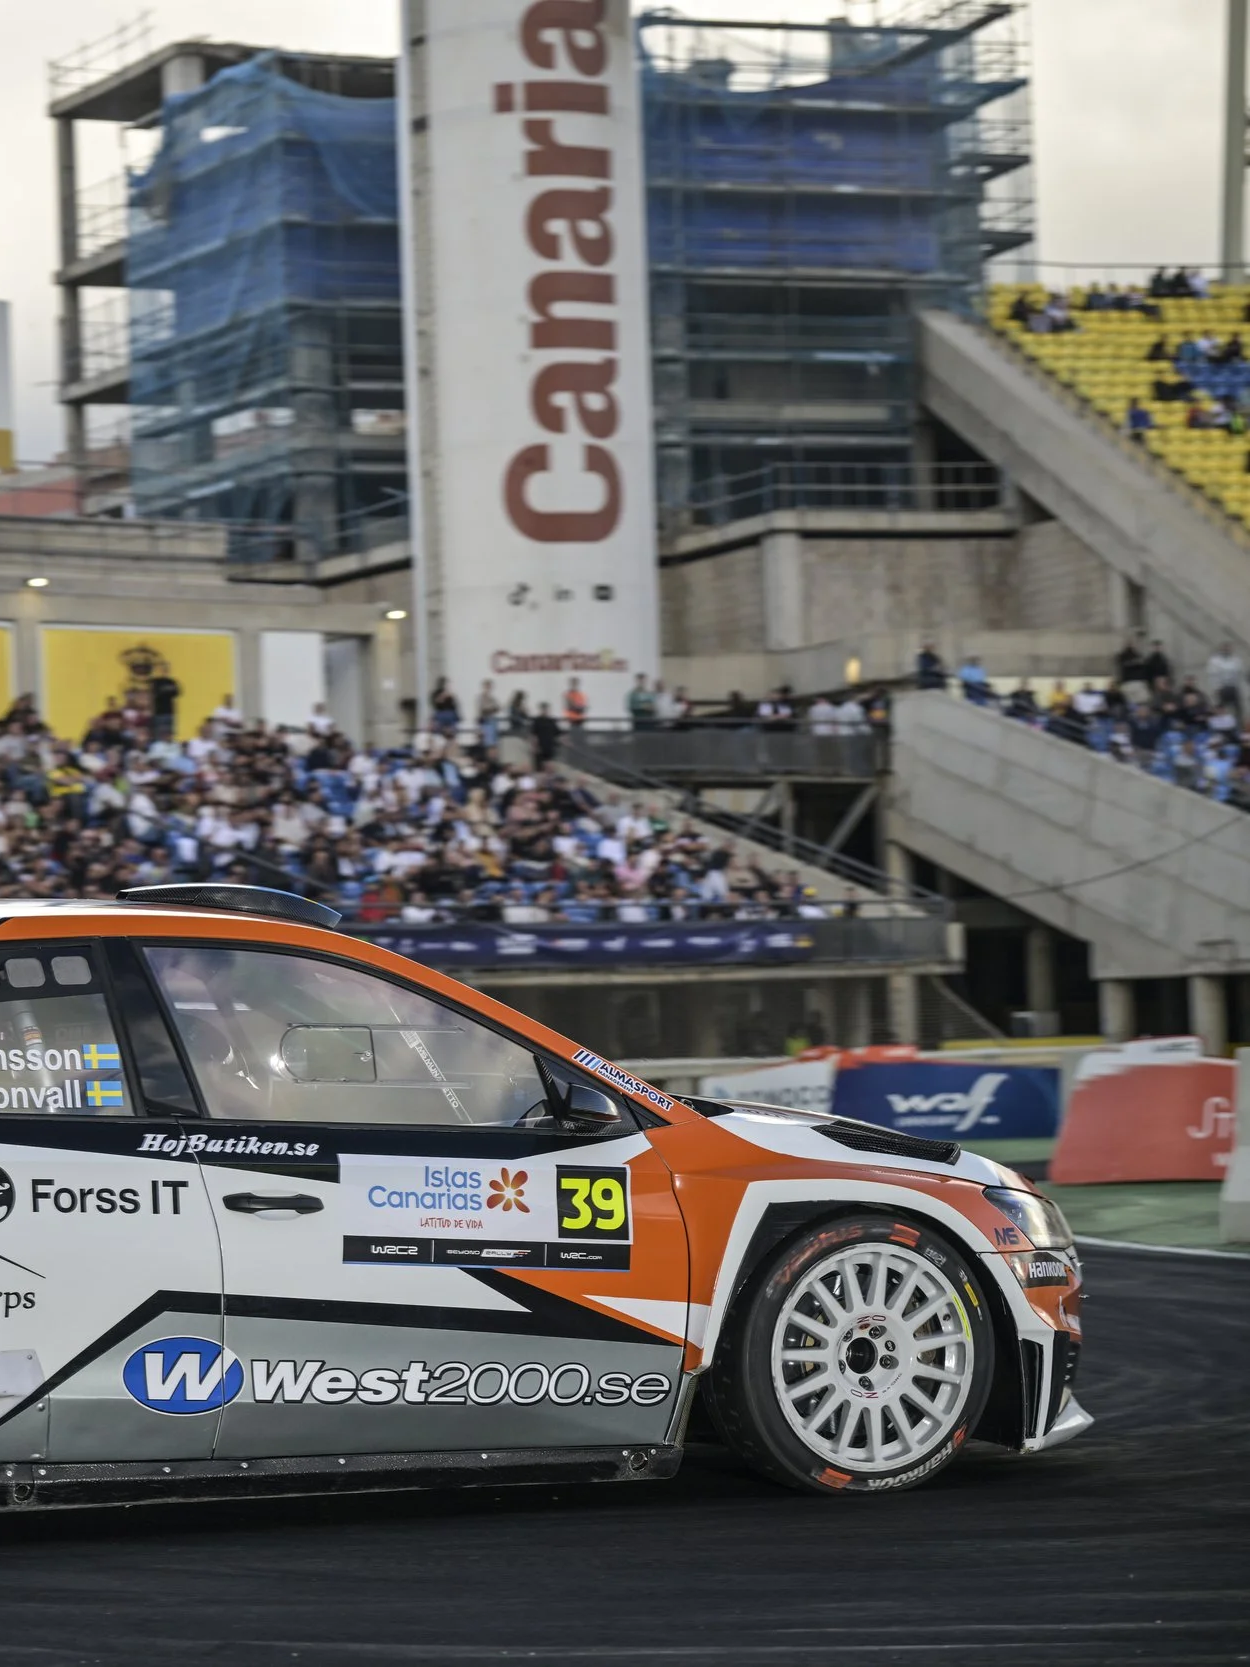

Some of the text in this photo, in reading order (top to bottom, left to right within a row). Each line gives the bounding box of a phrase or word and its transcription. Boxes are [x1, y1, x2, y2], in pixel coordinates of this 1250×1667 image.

[599, 1063, 673, 1111] ALMASPORT
[31, 1178, 189, 1215] Forss IT
[368, 1185, 483, 1212] Canarias
[424, 1165, 482, 1190] Islas
[560, 1177, 626, 1231] 39
[250, 1359, 671, 1407] West2000.se
